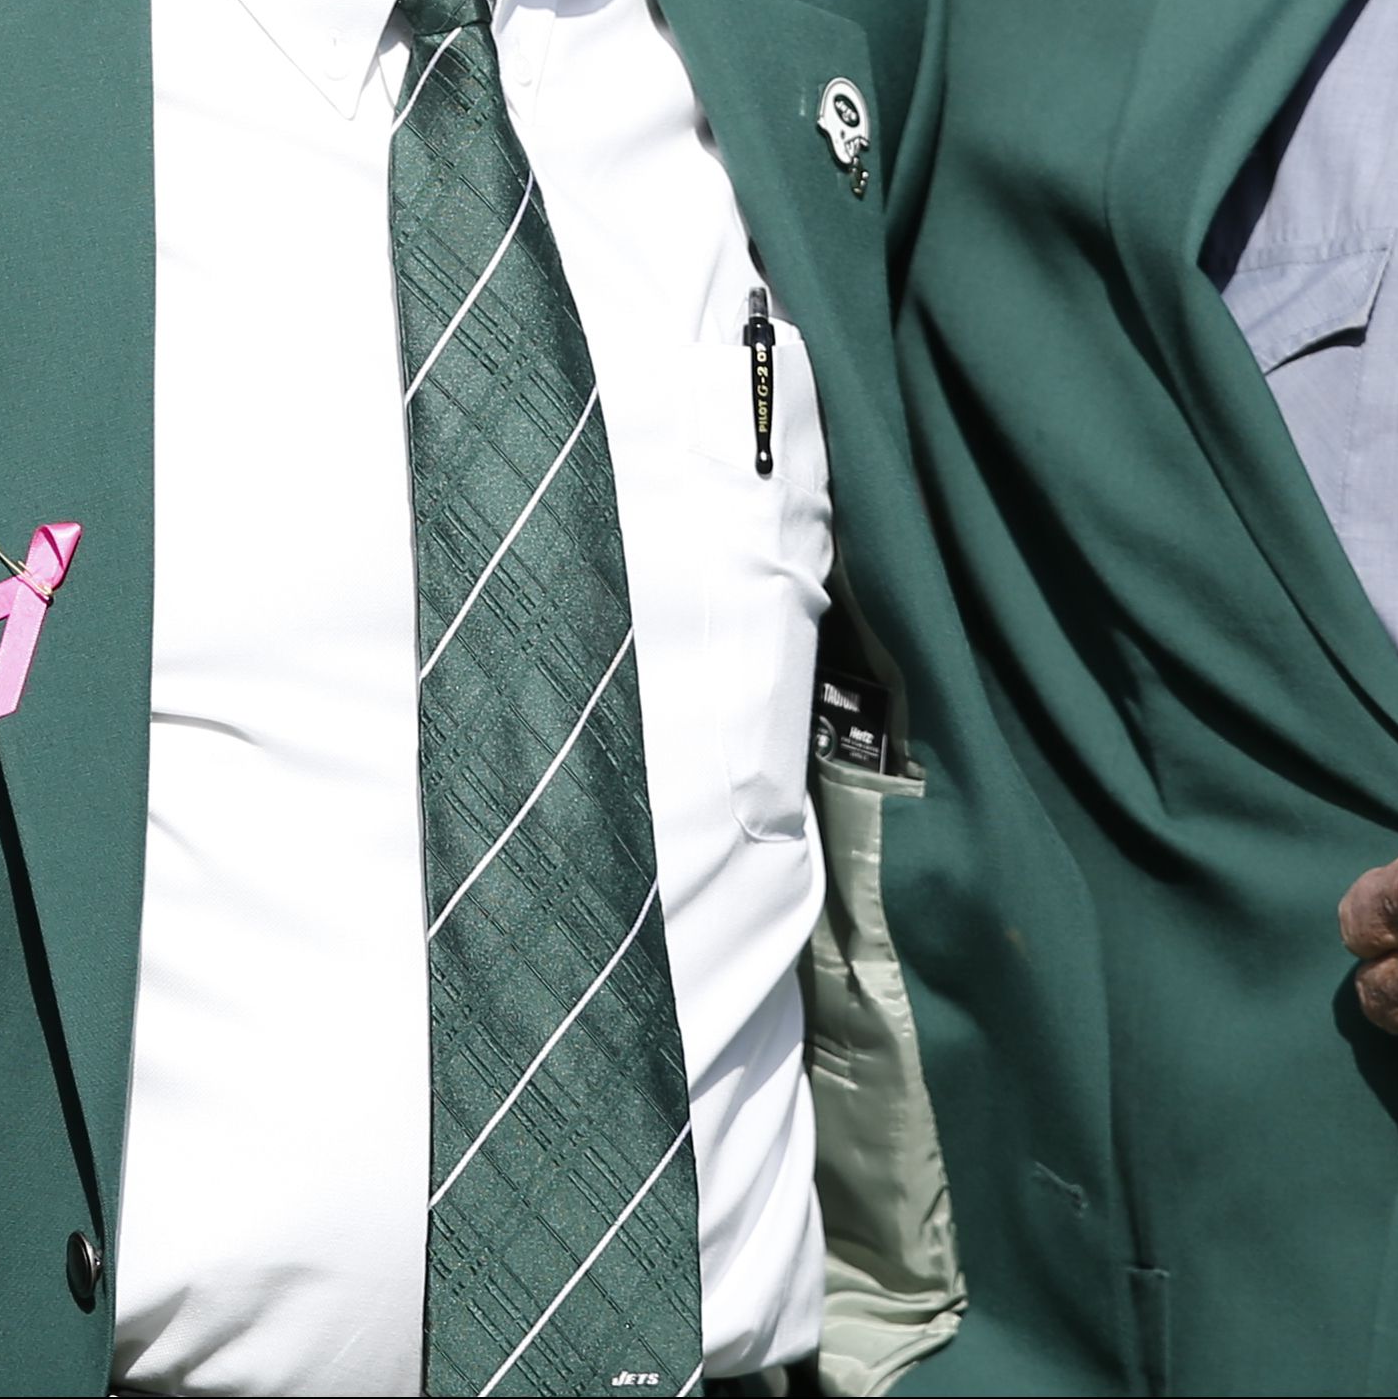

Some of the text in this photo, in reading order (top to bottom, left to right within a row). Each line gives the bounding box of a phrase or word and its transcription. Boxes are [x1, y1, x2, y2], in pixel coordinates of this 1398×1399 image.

[756, 366, 769, 397] G-2
[758, 400, 768, 433] PILOT
[611, 1370, 660, 1387] JETS
